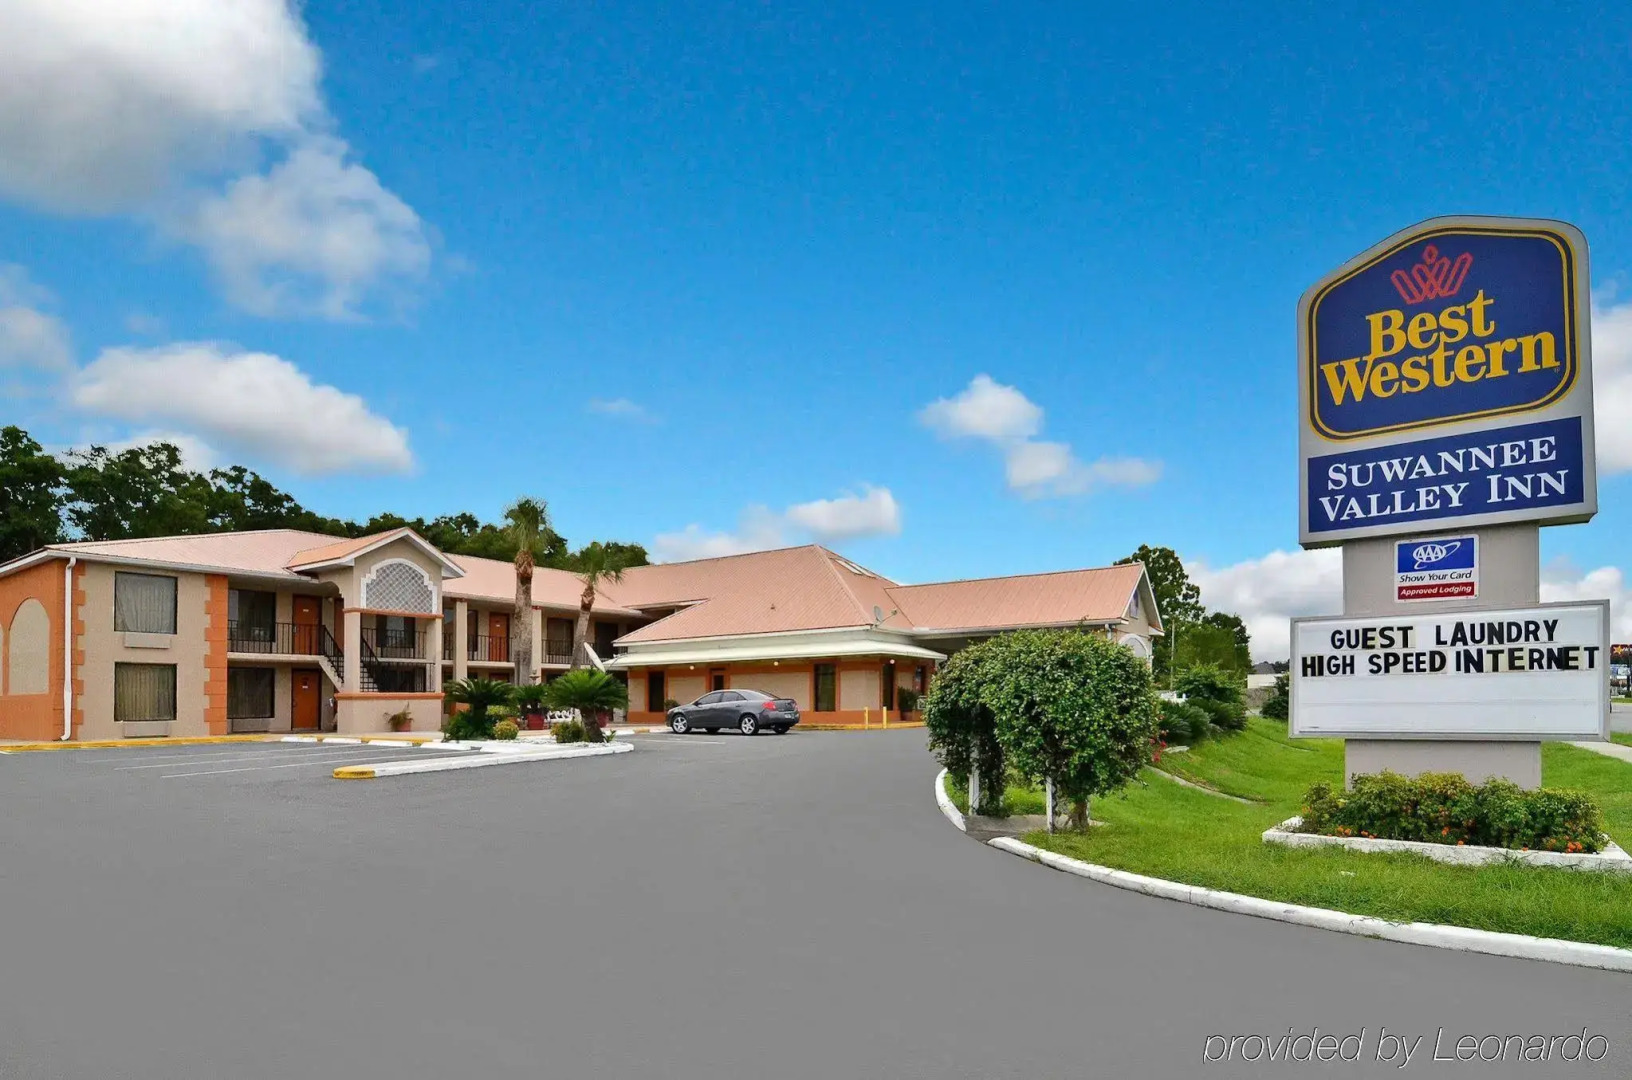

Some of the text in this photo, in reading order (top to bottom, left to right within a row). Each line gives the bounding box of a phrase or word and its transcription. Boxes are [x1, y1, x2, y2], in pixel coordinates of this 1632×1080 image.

[1366, 289, 1495, 358] Best
[1320, 331, 1560, 406] Western
[1327, 436, 1556, 491] SUWANNEE
[1319, 470, 1569, 522] VALLEY INN
[1416, 544, 1443, 561] AAA
[1400, 570, 1472, 583] Show Your Card
[1401, 585, 1472, 596] Approved Lodging
[1331, 619, 1559, 650] GUEST LAUNDRY
[1302, 646, 1600, 677] HIGH SPEED INTERNET
